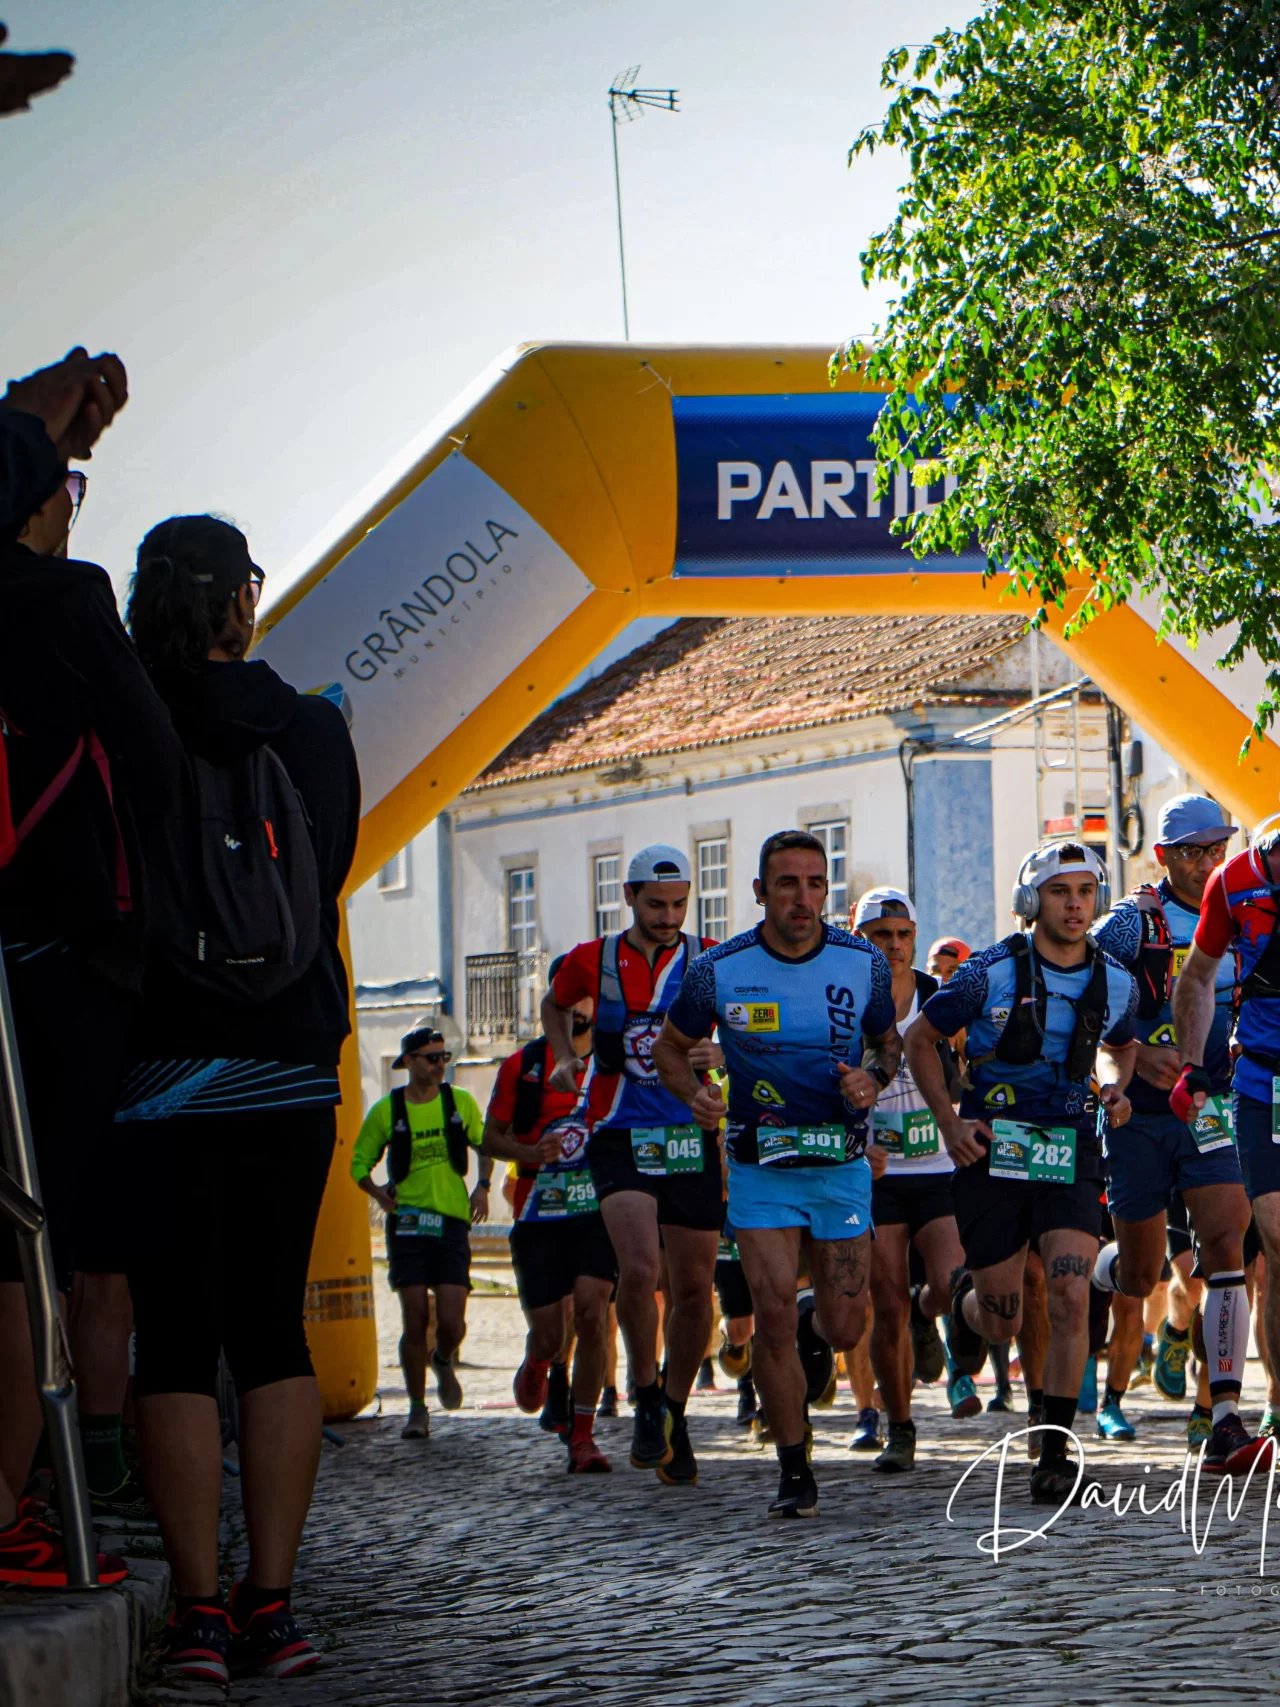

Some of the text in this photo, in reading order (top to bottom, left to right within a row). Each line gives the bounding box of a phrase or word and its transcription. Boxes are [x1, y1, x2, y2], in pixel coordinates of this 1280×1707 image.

[717, 458, 985, 519] PARTID
[345, 519, 519, 682] GRÂNDOLA
[802, 1133, 841, 1149] 301
[908, 1123, 935, 1145] 011
[667, 1138, 701, 1159] 045
[1031, 1143, 1073, 1167] 282
[567, 1183, 596, 1202] 259
[418, 1213, 442, 1227] 050
